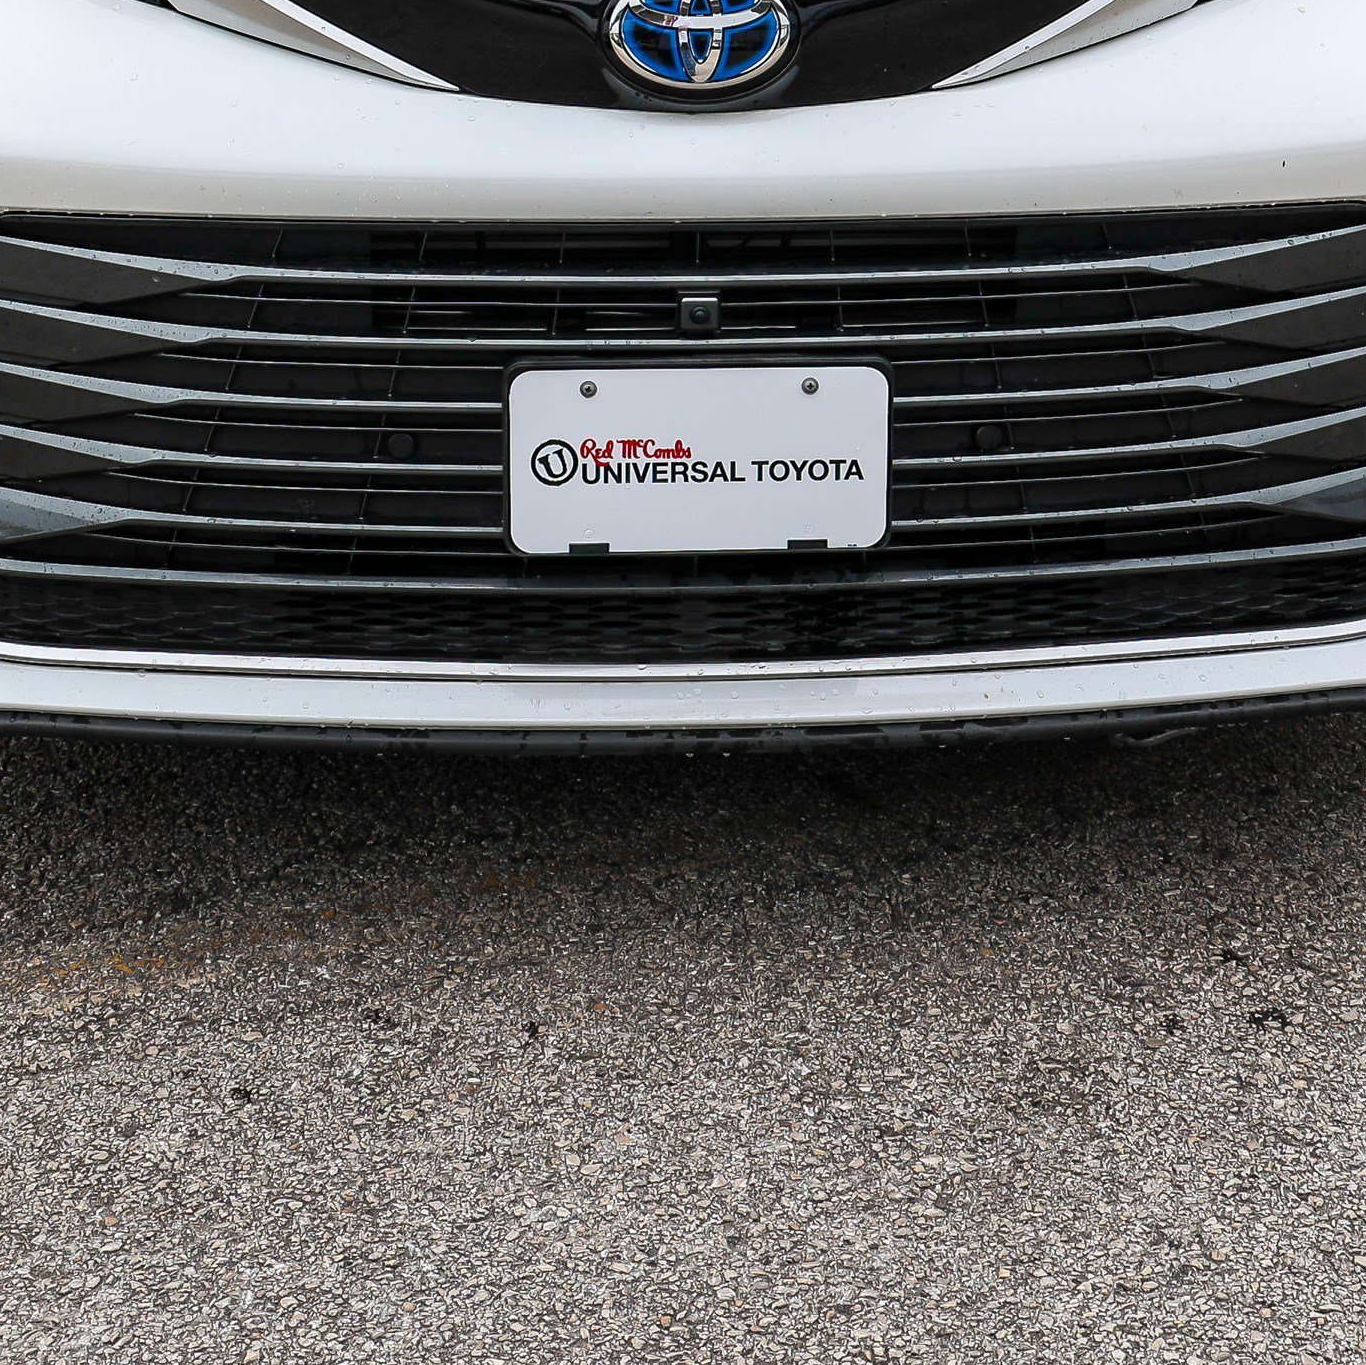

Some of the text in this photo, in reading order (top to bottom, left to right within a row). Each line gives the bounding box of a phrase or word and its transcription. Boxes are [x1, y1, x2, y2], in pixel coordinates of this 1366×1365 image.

[580, 439, 692, 466] Red McCombs
[581, 459, 865, 485] UNIVERSAL TOYOTA
